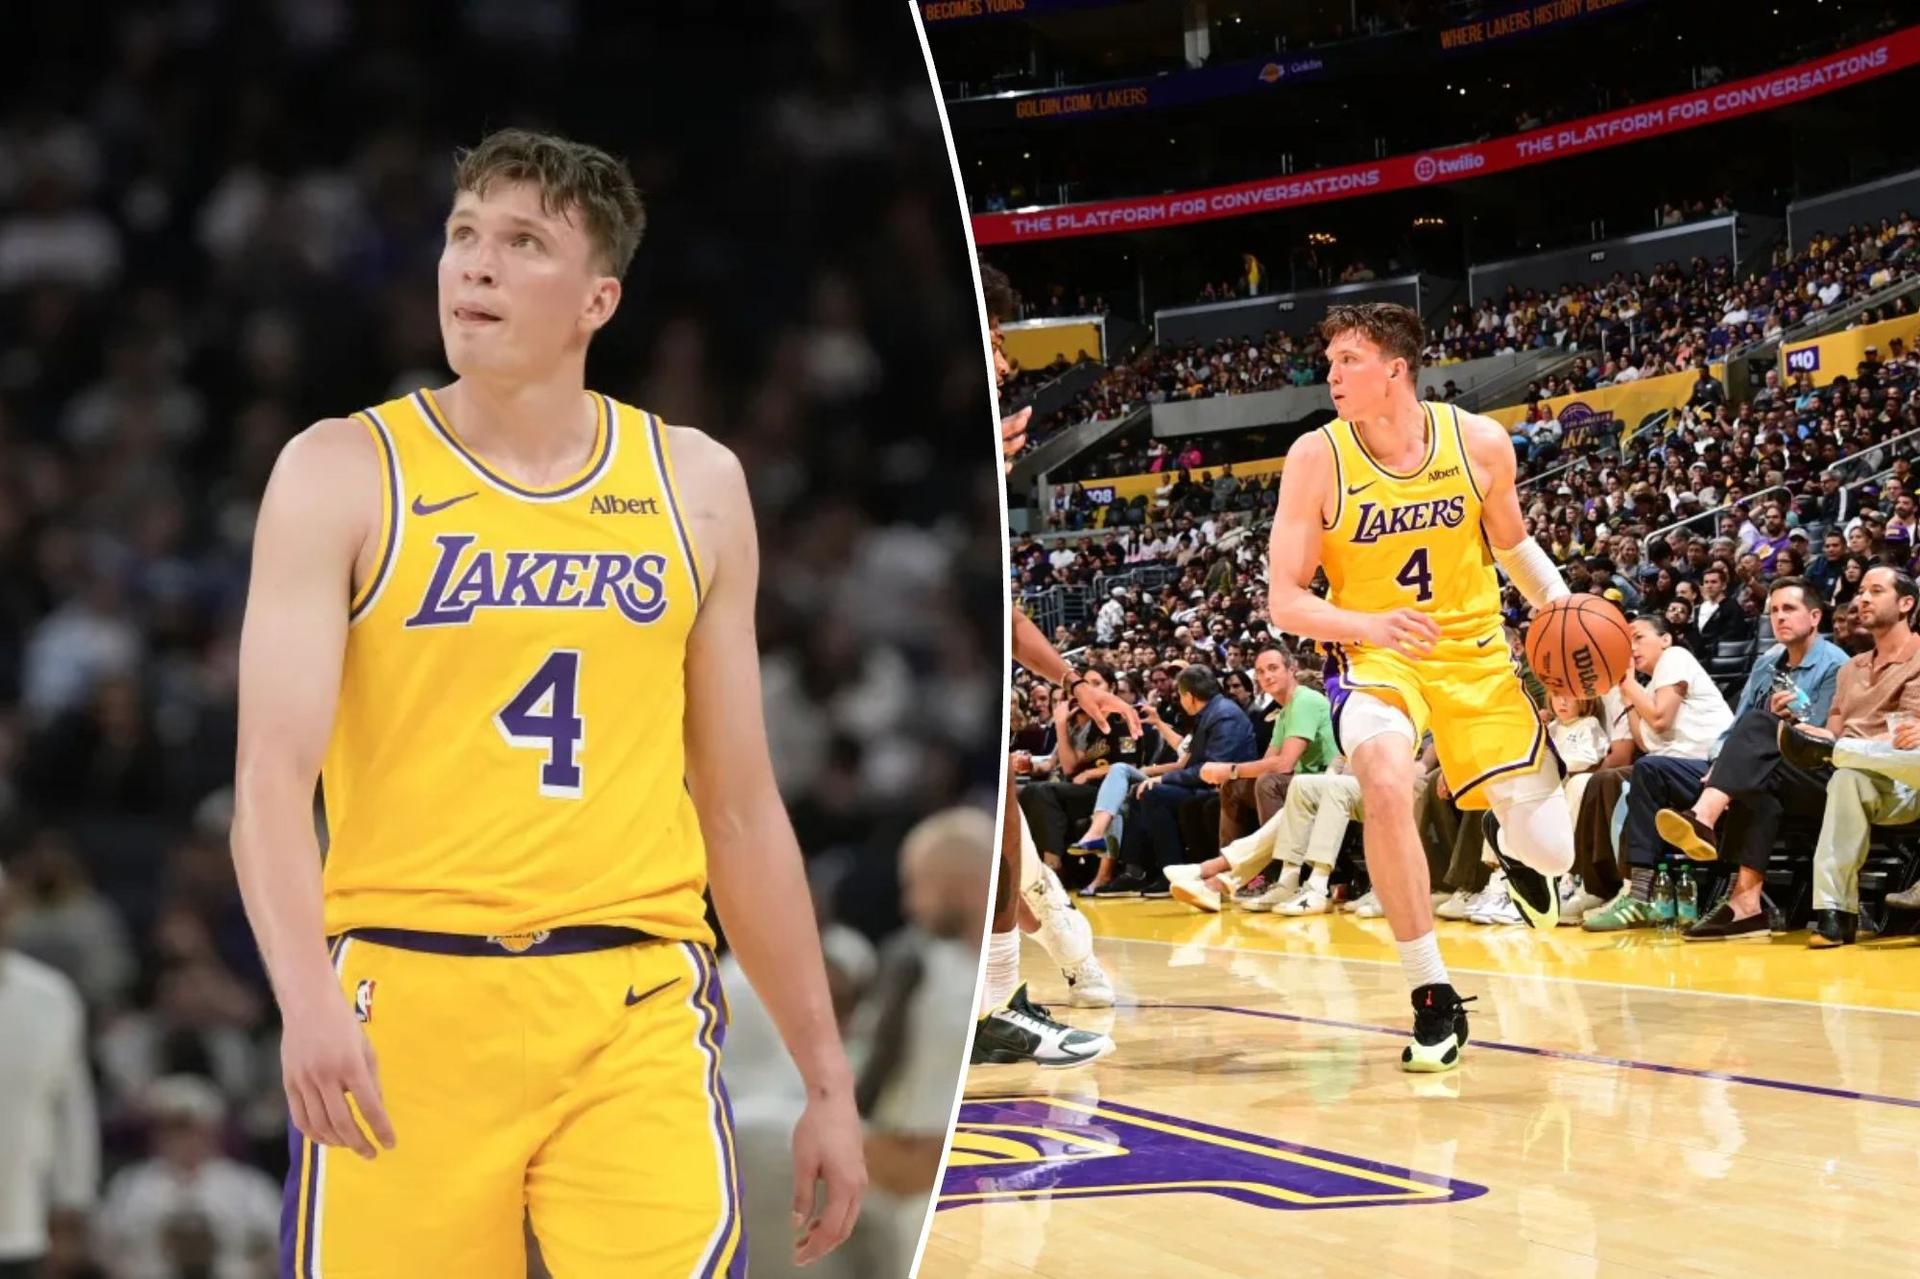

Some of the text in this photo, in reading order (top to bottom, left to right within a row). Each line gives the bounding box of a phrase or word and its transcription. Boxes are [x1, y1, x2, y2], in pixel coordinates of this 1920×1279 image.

[926, 0, 983, 21] BECOMES
[1440, 23, 1485, 50] WHERE
[1486, 10, 1531, 39] LAKERS
[1533, 0, 1582, 26] HISTORY
[1016, 88, 1148, 119] GOLDIN.COM/LAKERS
[1516, 47, 1888, 157] THE PLATFORM FOR CONVERSATIONS
[1438, 154, 1485, 175] twilio
[1011, 170, 1380, 235] THE PLATFORM FOR CONVERSATIONS
[1789, 350, 1814, 370] 110
[1427, 465, 1461, 482] Albert
[589, 494, 660, 515] Albert
[1348, 495, 1466, 544] LAKERS
[404, 533, 669, 629] LAKERS
[1394, 547, 1434, 602] 4
[1572, 644, 1598, 698] Wilso
[491, 648, 586, 800] 4
